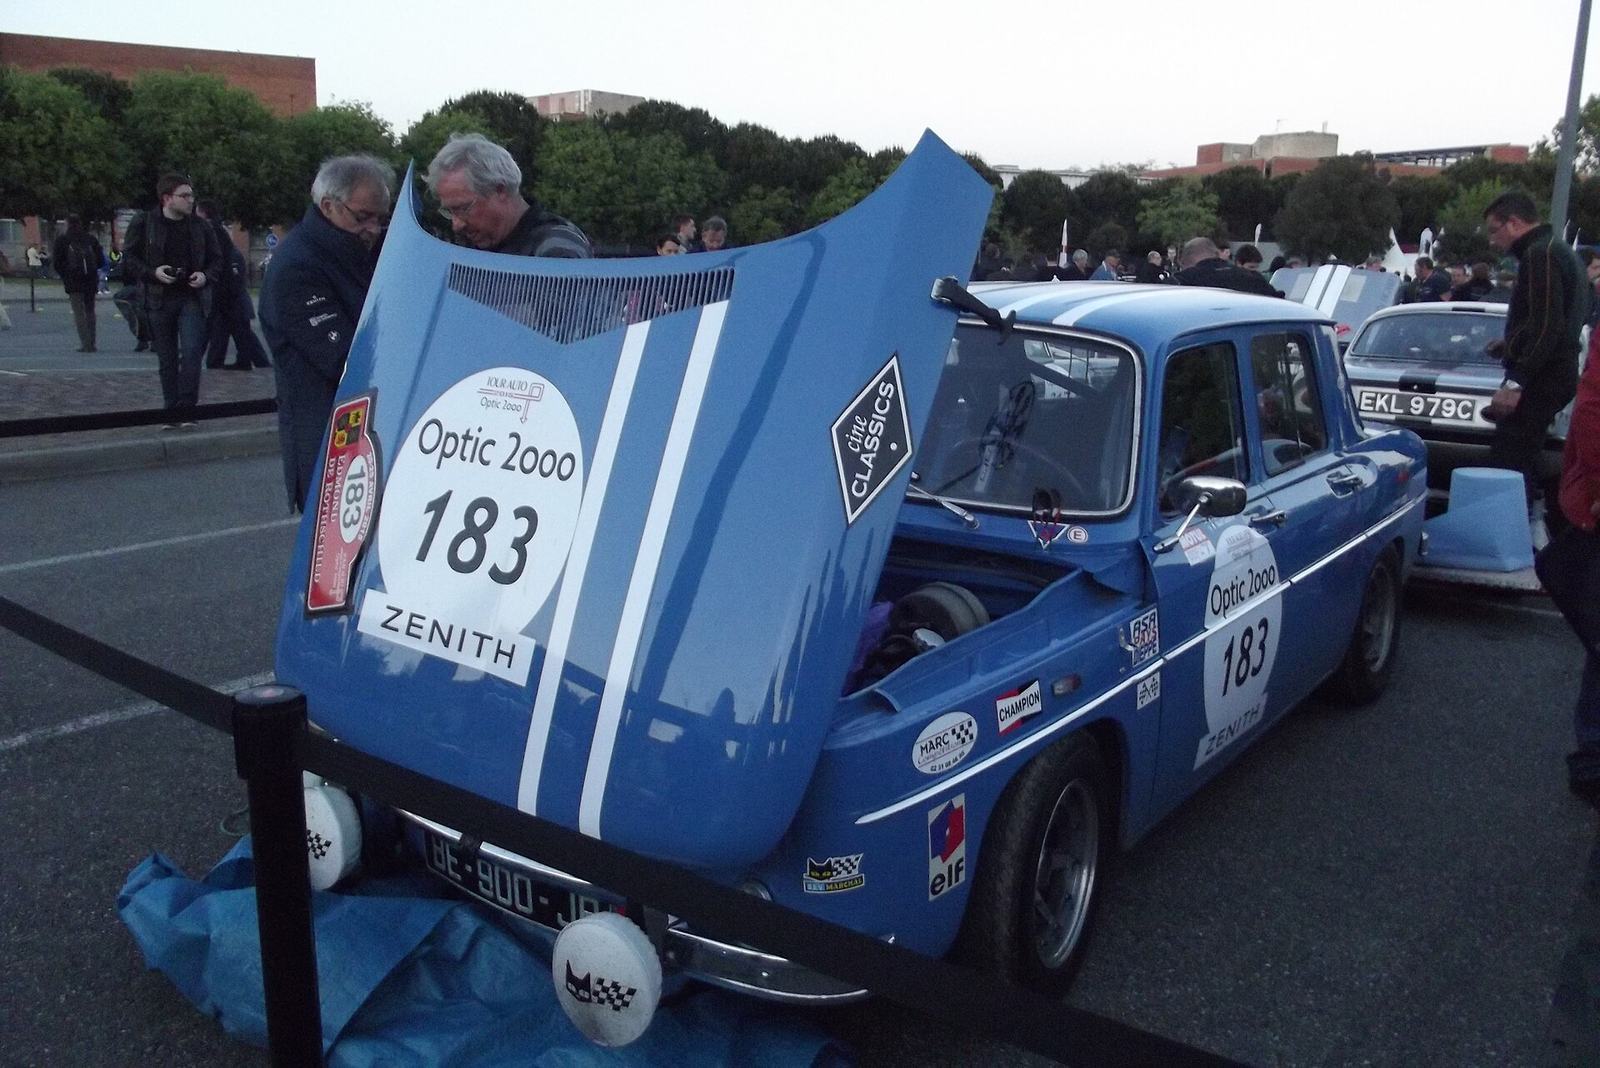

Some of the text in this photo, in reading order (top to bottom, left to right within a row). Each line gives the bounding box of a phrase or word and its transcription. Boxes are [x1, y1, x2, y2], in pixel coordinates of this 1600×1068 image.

[480, 397, 522, 412] Optic 2000
[487, 376, 528, 391] TOUR AUTO
[1360, 391, 1472, 419] EKL 979C
[418, 418, 576, 482] Optic 2000
[845, 415, 867, 453] cine
[851, 381, 895, 498] CLASSICS
[330, 454, 346, 523] EDMOND
[342, 465, 366, 529] 183
[314, 457, 336, 583] DE ROTHSCHILD
[415, 489, 539, 586] 183
[1210, 564, 1275, 619] Optic 2000
[380, 604, 516, 669] ZENITH
[1222, 617, 1268, 697] 183
[999, 691, 1040, 722] CHAMPION
[1205, 703, 1260, 756] ZENITH
[920, 733, 949, 757] MARC
[826, 877, 863, 891] MARCHAL
[930, 857, 964, 897] elf
